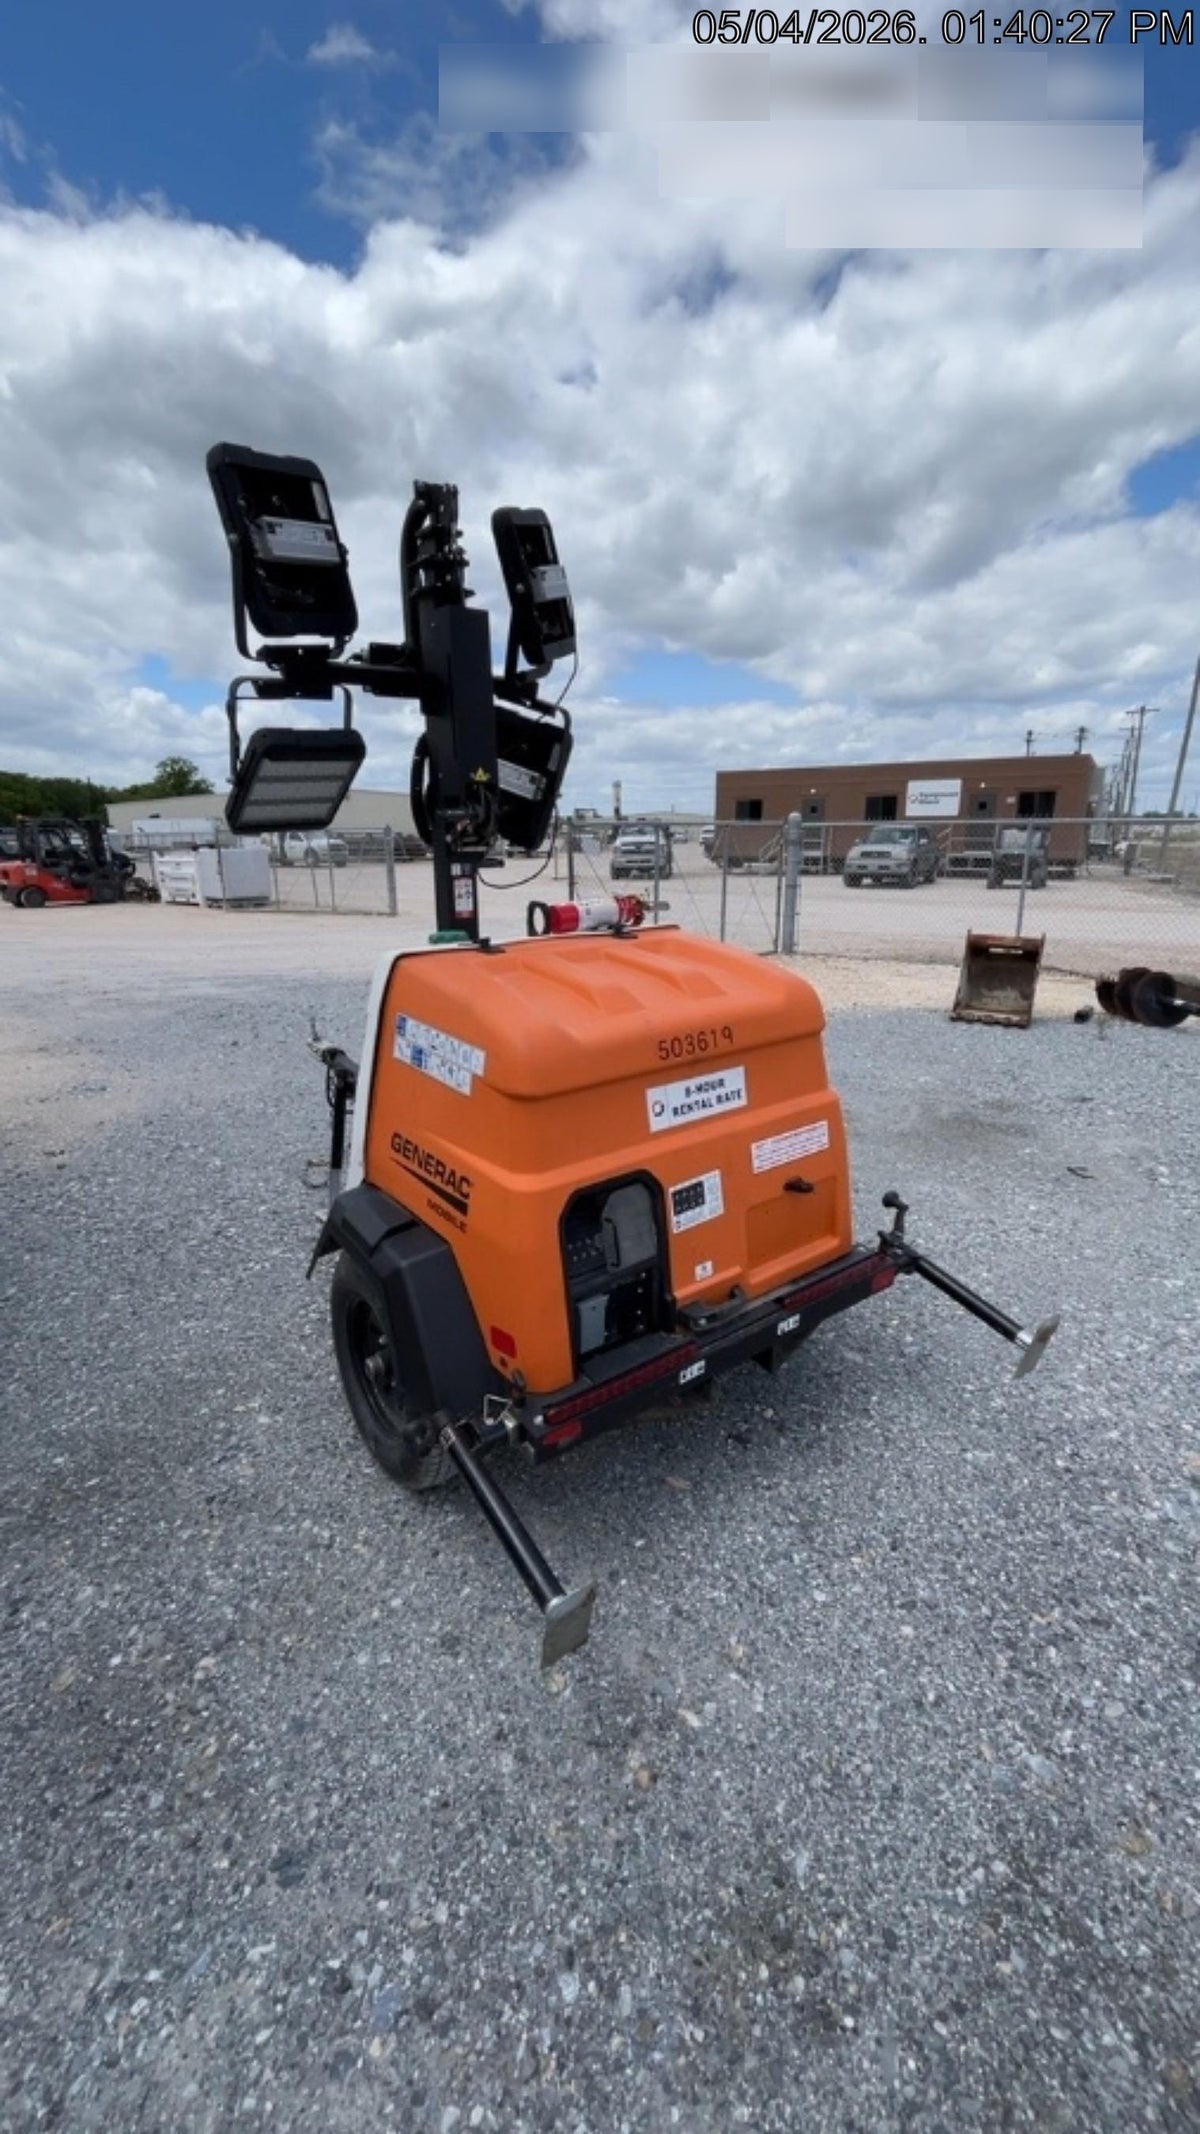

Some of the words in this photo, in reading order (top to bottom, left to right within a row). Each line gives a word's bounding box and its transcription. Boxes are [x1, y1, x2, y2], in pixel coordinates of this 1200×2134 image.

[657, 1025, 734, 1060] 503619
[672, 1098, 714, 1117] RENTAL
[390, 1131, 471, 1200] GENERAC
